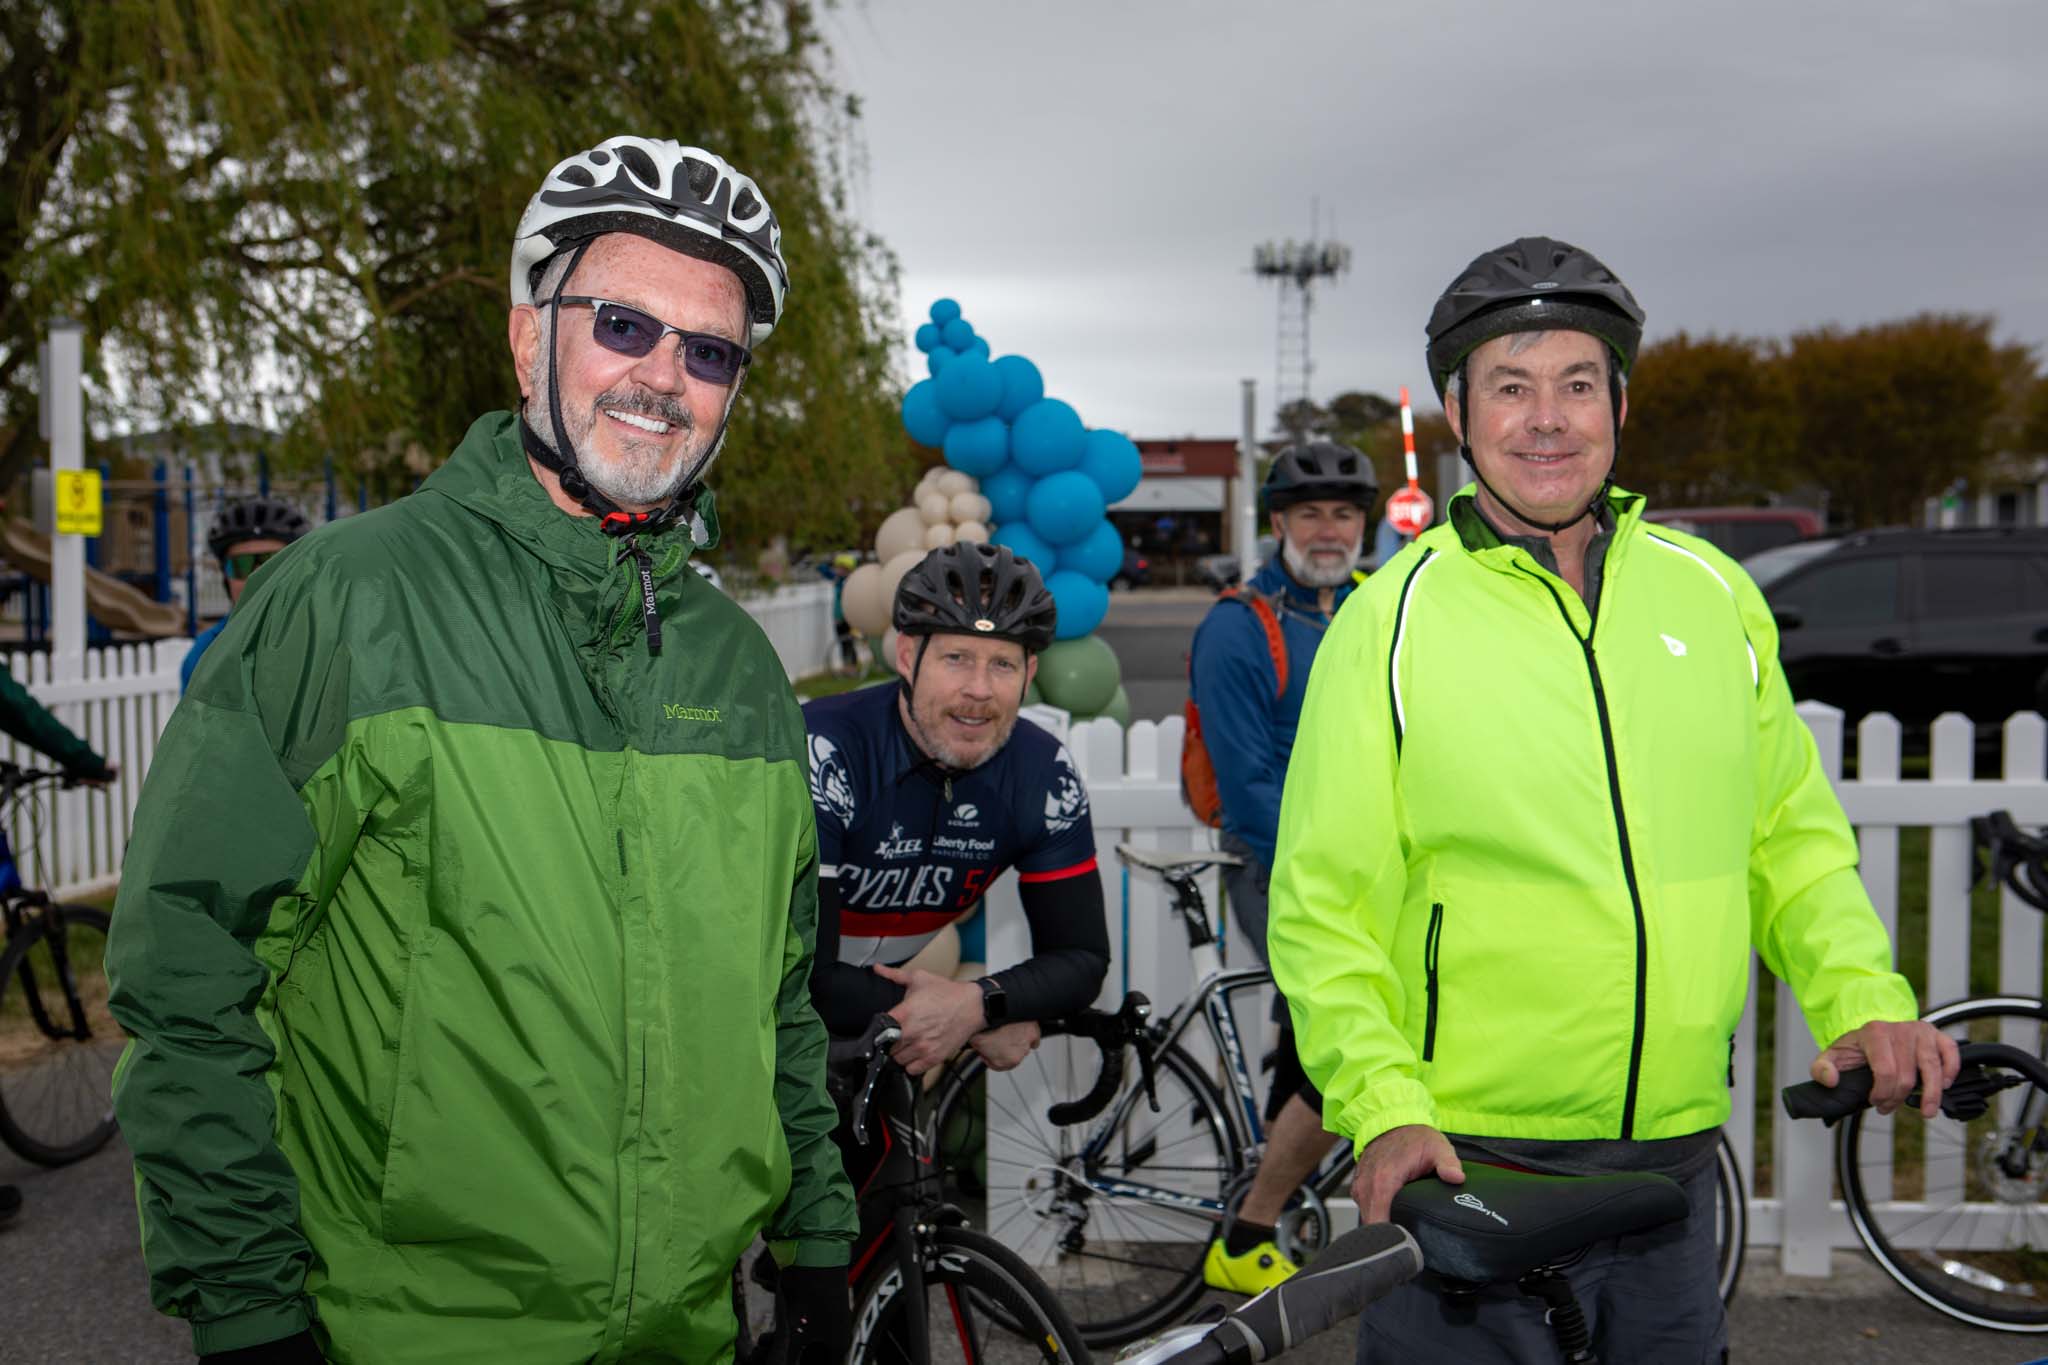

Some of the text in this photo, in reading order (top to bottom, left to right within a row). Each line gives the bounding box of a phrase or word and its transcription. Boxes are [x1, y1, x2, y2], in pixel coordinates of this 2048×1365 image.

[1391, 501, 1428, 523] STP
[641, 569, 656, 615] Marmot
[663, 703, 721, 722] Marmot
[932, 834, 995, 851] Liberty Food
[956, 865, 999, 908] 5
